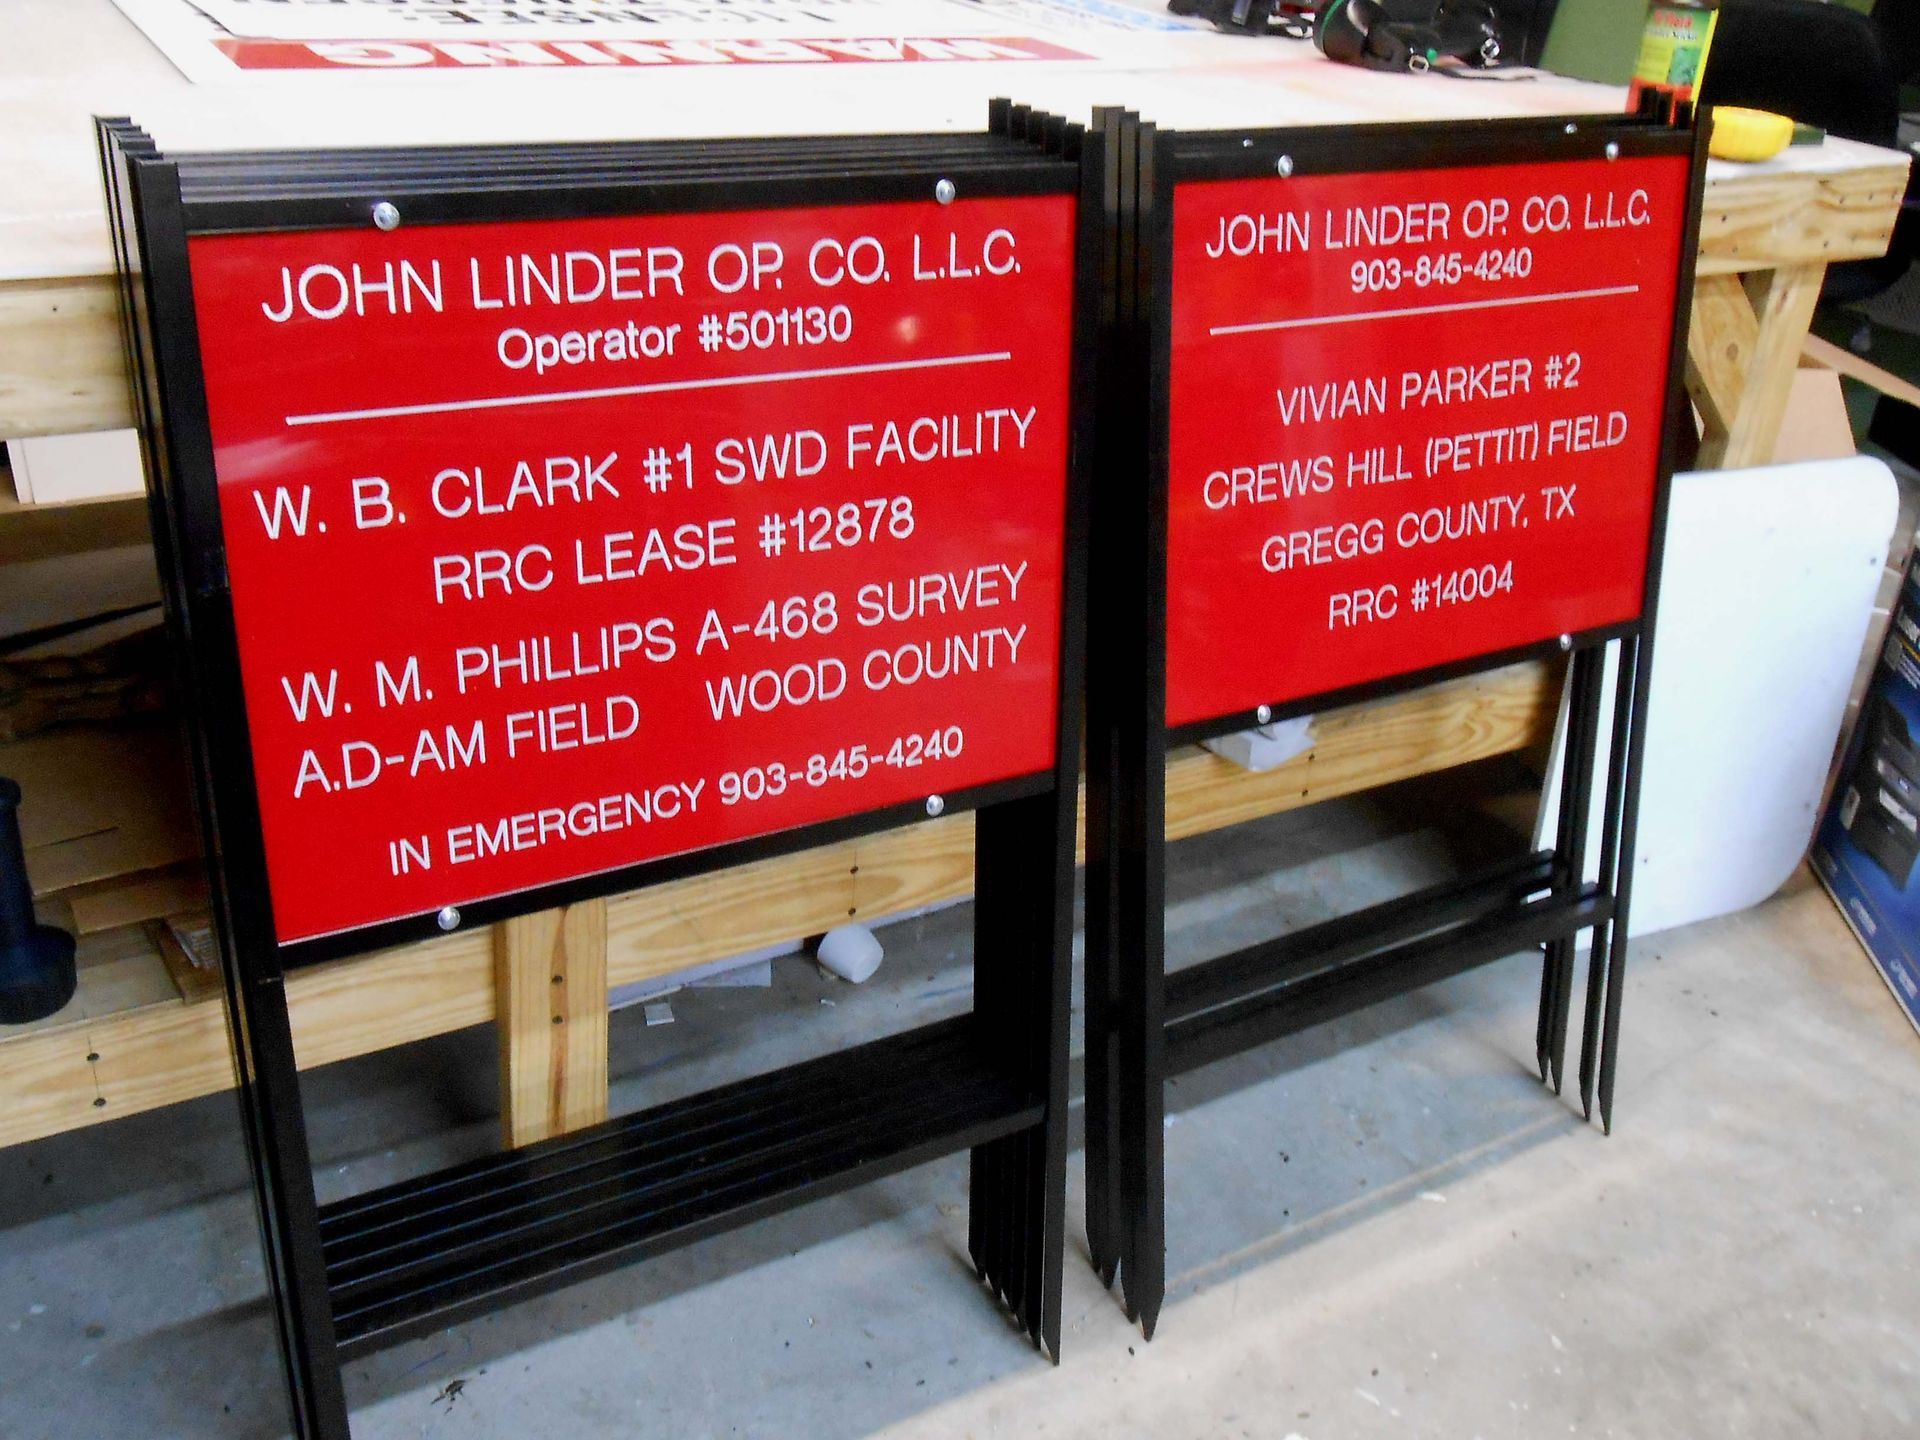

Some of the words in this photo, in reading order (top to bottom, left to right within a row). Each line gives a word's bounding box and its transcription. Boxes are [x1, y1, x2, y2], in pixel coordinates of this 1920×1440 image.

[304, 38, 1040, 67] WARNING
[1206, 211, 1310, 258] JOHN
[1325, 203, 1450, 249] LINDER
[1463, 199, 1509, 238] OP.
[1522, 195, 1571, 235] CO.
[1584, 189, 1651, 229] L.L.C.
[262, 260, 443, 322] JOHN
[471, 247, 683, 309] LINDER
[708, 242, 784, 293] OP.
[809, 237, 890, 286] CO.
[914, 229, 1020, 280] L.L.C.
[1351, 247, 1532, 293] 903-845-4240
[498, 323, 681, 375] Operator
[698, 305, 852, 352] #501130
[1277, 377, 1386, 426] VIVIAN
[1401, 359, 1532, 409] PARKER
[1545, 352, 1581, 389] #2
[253, 485, 327, 540] W.
[352, 477, 406, 532] B.
[432, 452, 619, 519] CLARK
[643, 443, 692, 493] #1
[716, 430, 826, 484] SWD
[848, 407, 1036, 469] FACILITY
[1204, 456, 1333, 510] CREWS
[1347, 445, 1412, 487] HILL
[1426, 422, 1539, 477] (PETTIT)
[1548, 411, 1627, 455] FIELD
[434, 545, 553, 605] RRC
[576, 518, 736, 584] LEASE
[759, 496, 914, 559] #12878
[1262, 519, 1383, 572] GREGG
[1397, 494, 1528, 547] COUNTY,
[1542, 484, 1577, 520] TX
[1329, 585, 1397, 630] RRC
[1411, 561, 1513, 612] #14004
[282, 669, 352, 722] W.
[376, 656, 432, 707] M.
[456, 618, 676, 694] PHILLIPS
[696, 591, 838, 655] A-468
[857, 561, 1027, 626] SURVEY
[294, 720, 486, 798] A.D-AM
[507, 695, 639, 758] FIELD
[706, 658, 846, 720] WOOD
[863, 624, 1026, 690] COUNTY
[390, 836, 430, 875] IN
[448, 778, 705, 864] EMERGENCY
[719, 726, 963, 805] 903-845-4240
